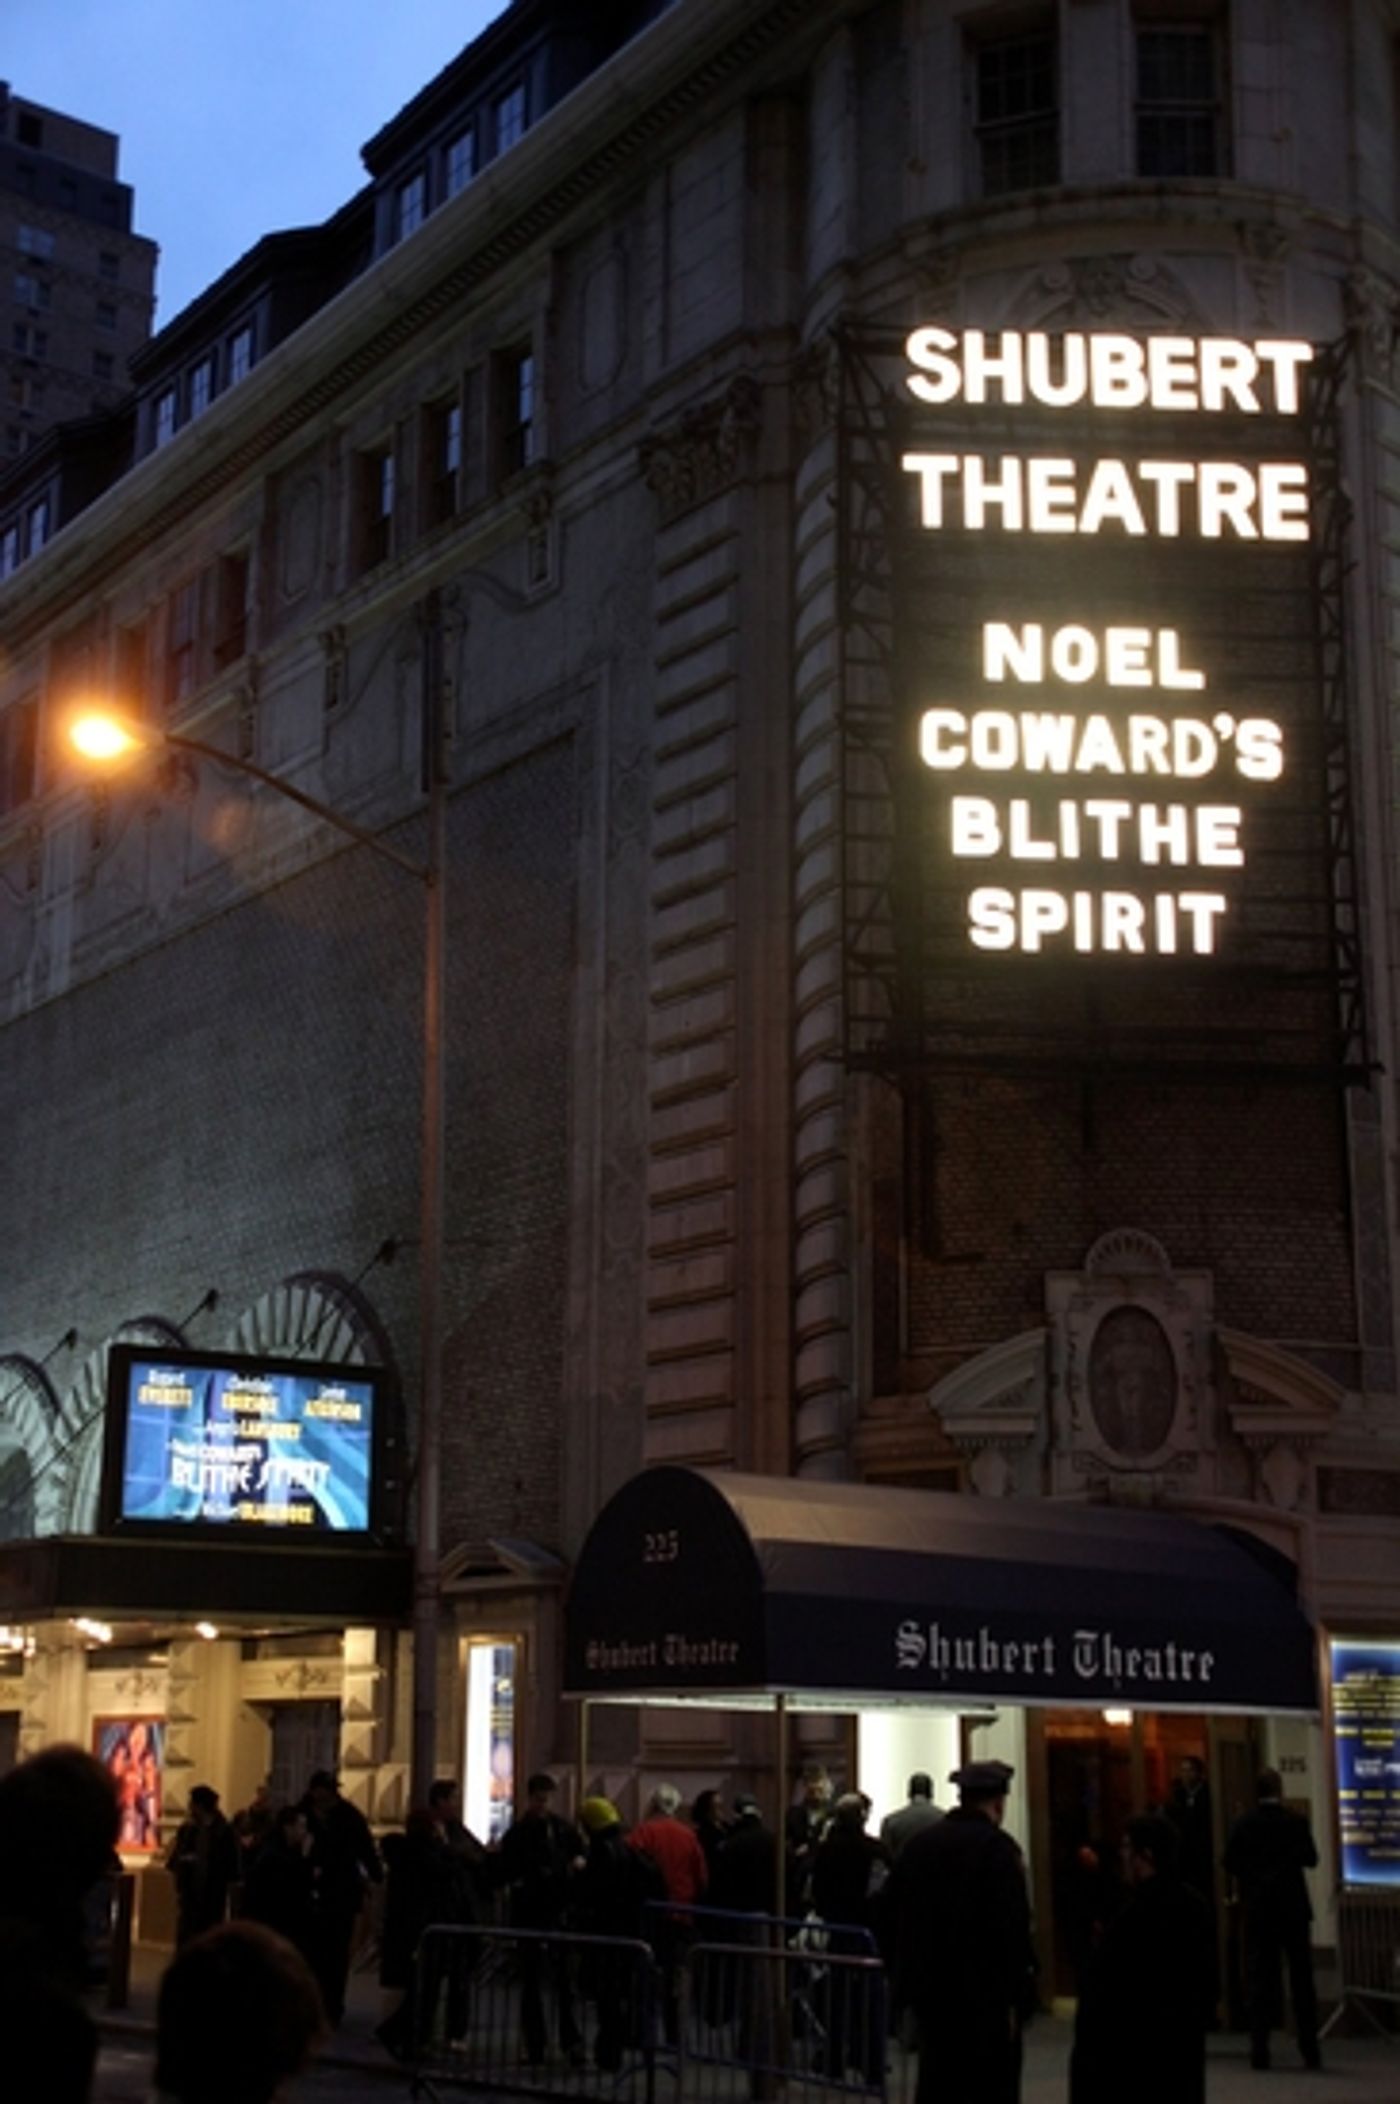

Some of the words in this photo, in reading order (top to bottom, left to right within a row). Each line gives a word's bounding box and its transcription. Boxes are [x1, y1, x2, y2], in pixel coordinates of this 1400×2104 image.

[905, 326, 1314, 414] SHUBERT
[902, 453, 1311, 541] THEATRE
[982, 621, 1206, 691] NOEL
[918, 708, 1284, 782] COWARD'S
[949, 794, 1245, 867] BLITHE
[967, 886, 1227, 955] SPIRIT
[895, 1620, 1055, 1681] Shubert
[1072, 1629, 1215, 1689] Theatre
